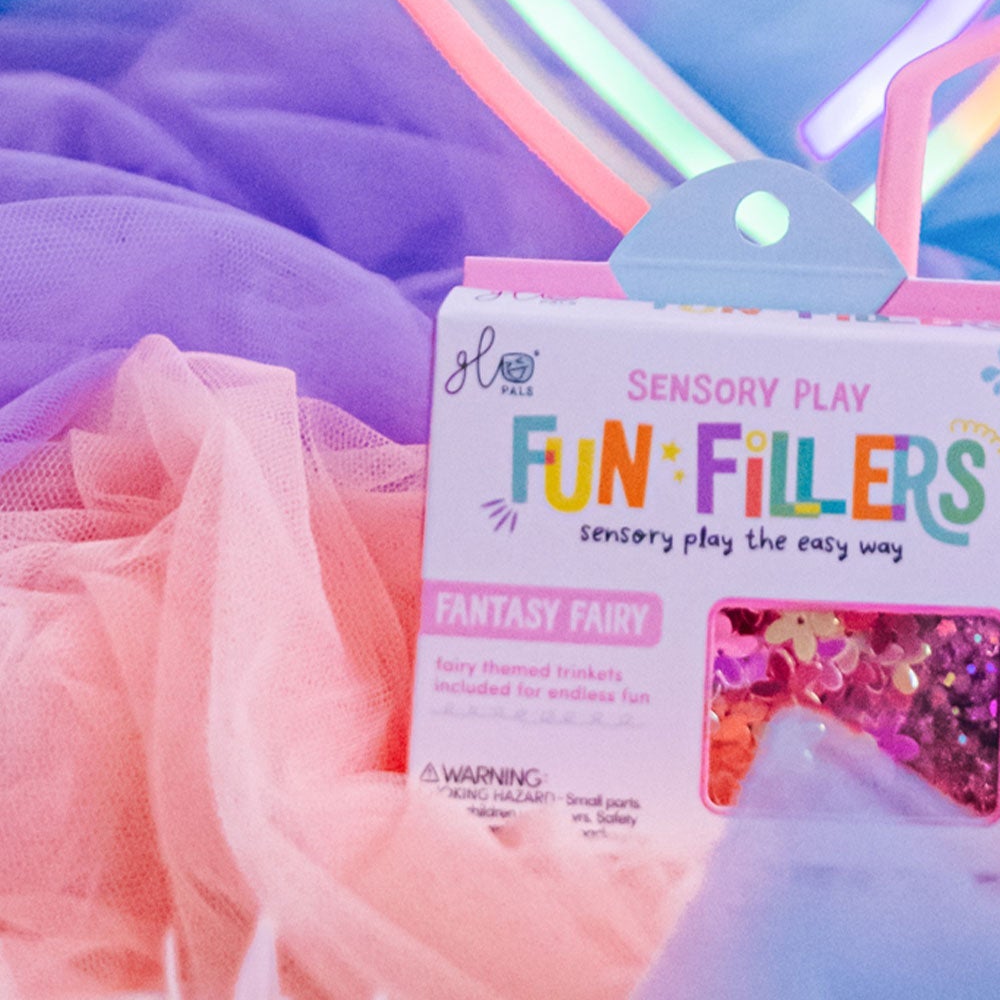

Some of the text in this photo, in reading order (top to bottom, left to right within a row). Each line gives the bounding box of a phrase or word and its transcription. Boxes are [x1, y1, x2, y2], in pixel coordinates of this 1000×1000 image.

[501, 385, 533, 397] PALS
[627, 369, 871, 413] SENSORY PLAY
[511, 415, 653, 513] FUN
[580, 525, 904, 563] sensory play the easy way
[435, 592, 650, 636] FANTASY FAIRY
[436, 656, 623, 682] fairy themed trinkets
[434, 680, 650, 704] included for endless fun
[566, 792, 603, 806] Small
